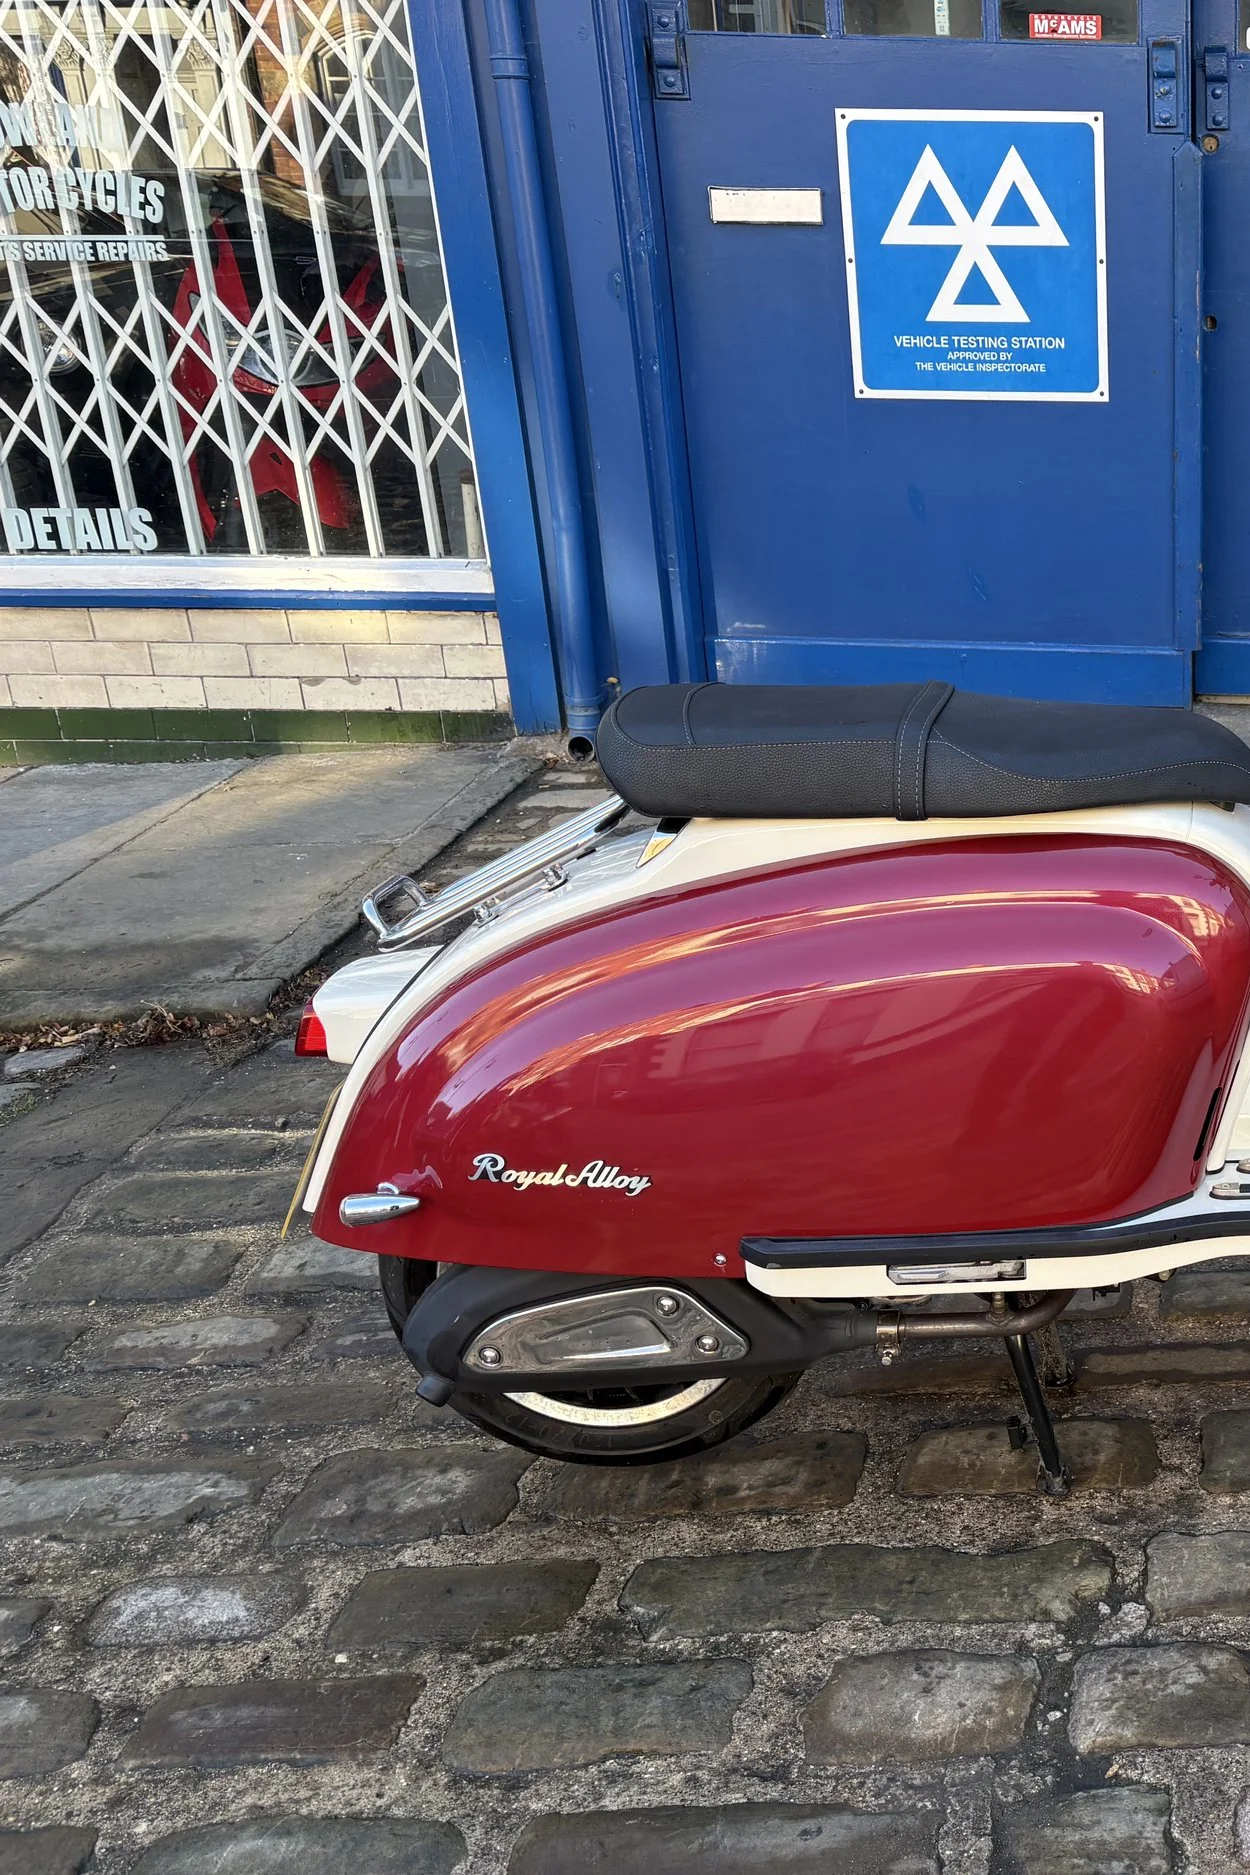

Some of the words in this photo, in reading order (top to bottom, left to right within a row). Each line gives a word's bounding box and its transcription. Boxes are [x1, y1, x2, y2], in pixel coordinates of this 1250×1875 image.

[56, 167, 165, 224] CYCLES
[22, 241, 95, 262] SERVICE
[96, 241, 169, 262] REPAIRS
[894, 335, 949, 347] VEHICLE
[951, 336, 1008, 348] TESTING
[1011, 337, 1065, 349] STATION
[947, 351, 998, 360] APPROVED
[1000, 352, 1013, 361] BY
[915, 362, 934, 371] THE
[936, 362, 974, 372] VEHICLE
[976, 363, 1046, 373] INSPECTORATE
[3, 507, 158, 551] DETAILS
[468, 1153, 568, 1191] Royal
[565, 1160, 652, 1197] Alloy
